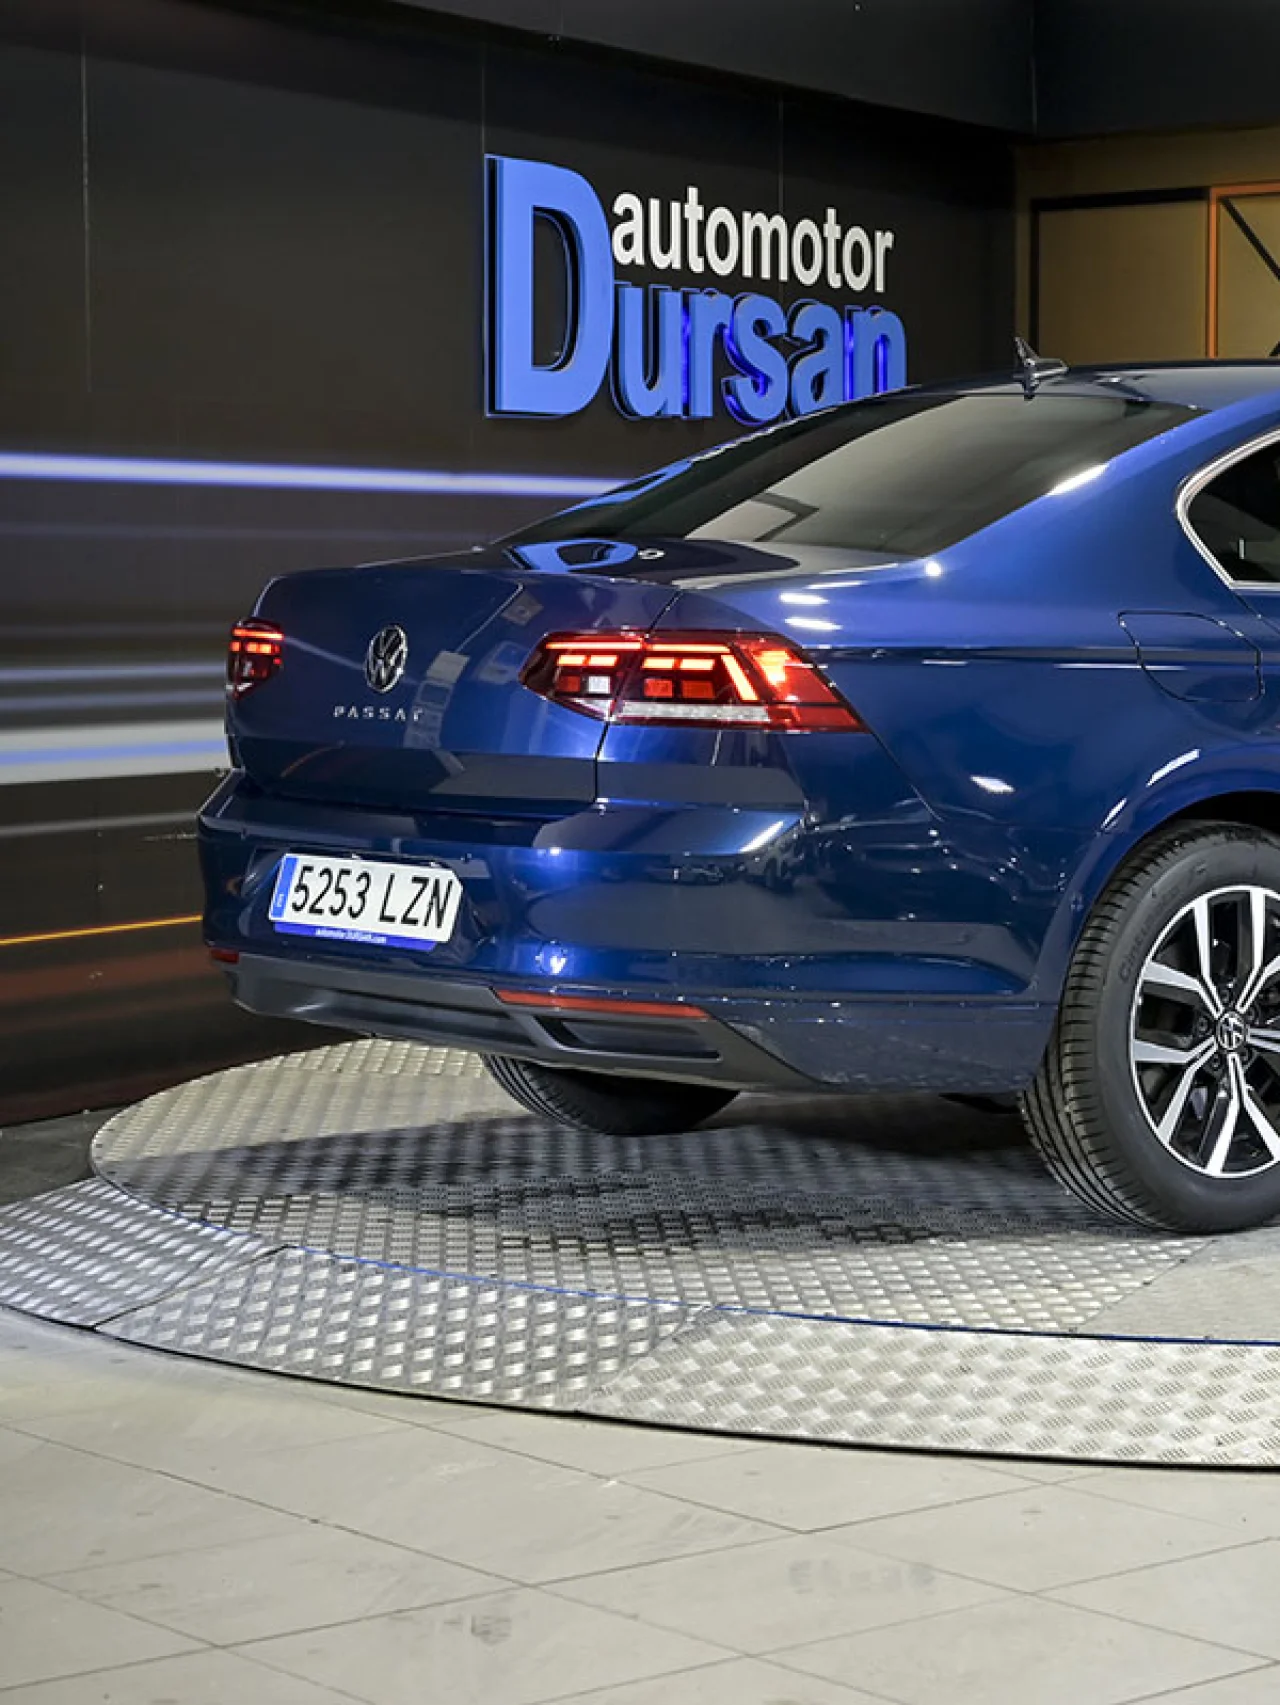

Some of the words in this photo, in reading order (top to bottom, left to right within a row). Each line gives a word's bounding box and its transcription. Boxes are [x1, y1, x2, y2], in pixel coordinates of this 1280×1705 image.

[485, 154, 907, 426] Dursan
[612, 186, 895, 293] automotor
[292, 865, 371, 920] 5253
[379, 873, 453, 929] LZN
